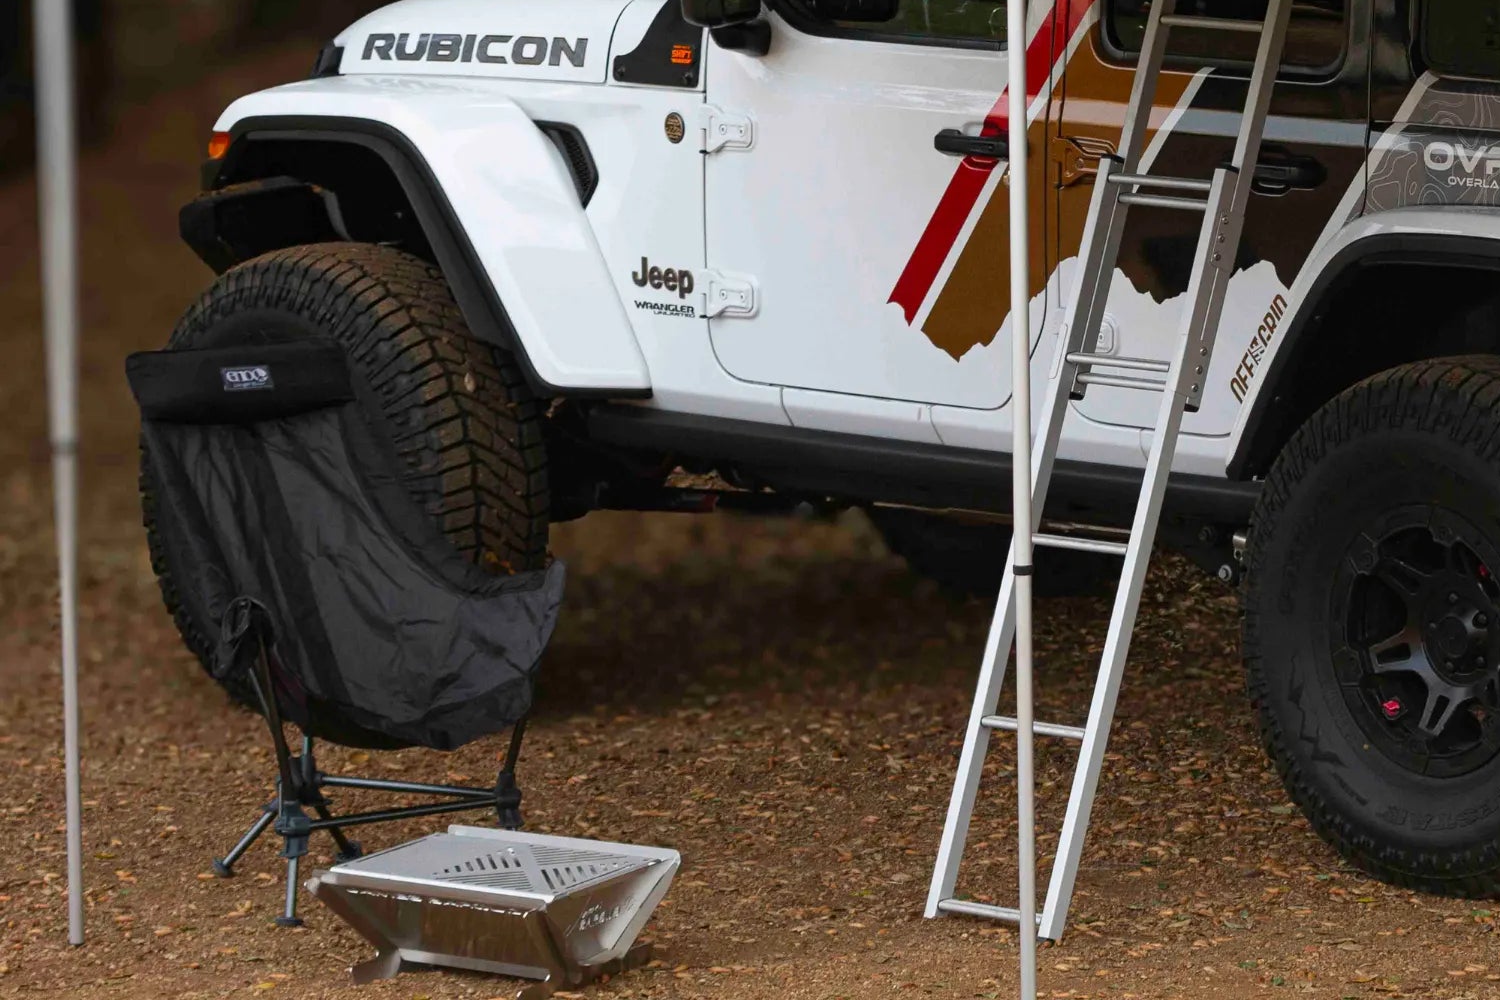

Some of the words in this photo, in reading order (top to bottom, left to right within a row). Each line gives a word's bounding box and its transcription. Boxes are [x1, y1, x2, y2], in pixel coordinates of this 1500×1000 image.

[361, 32, 589, 68] RUBICON
[631, 256, 695, 300] Jeep
[633, 299, 695, 316] WRANGLER
